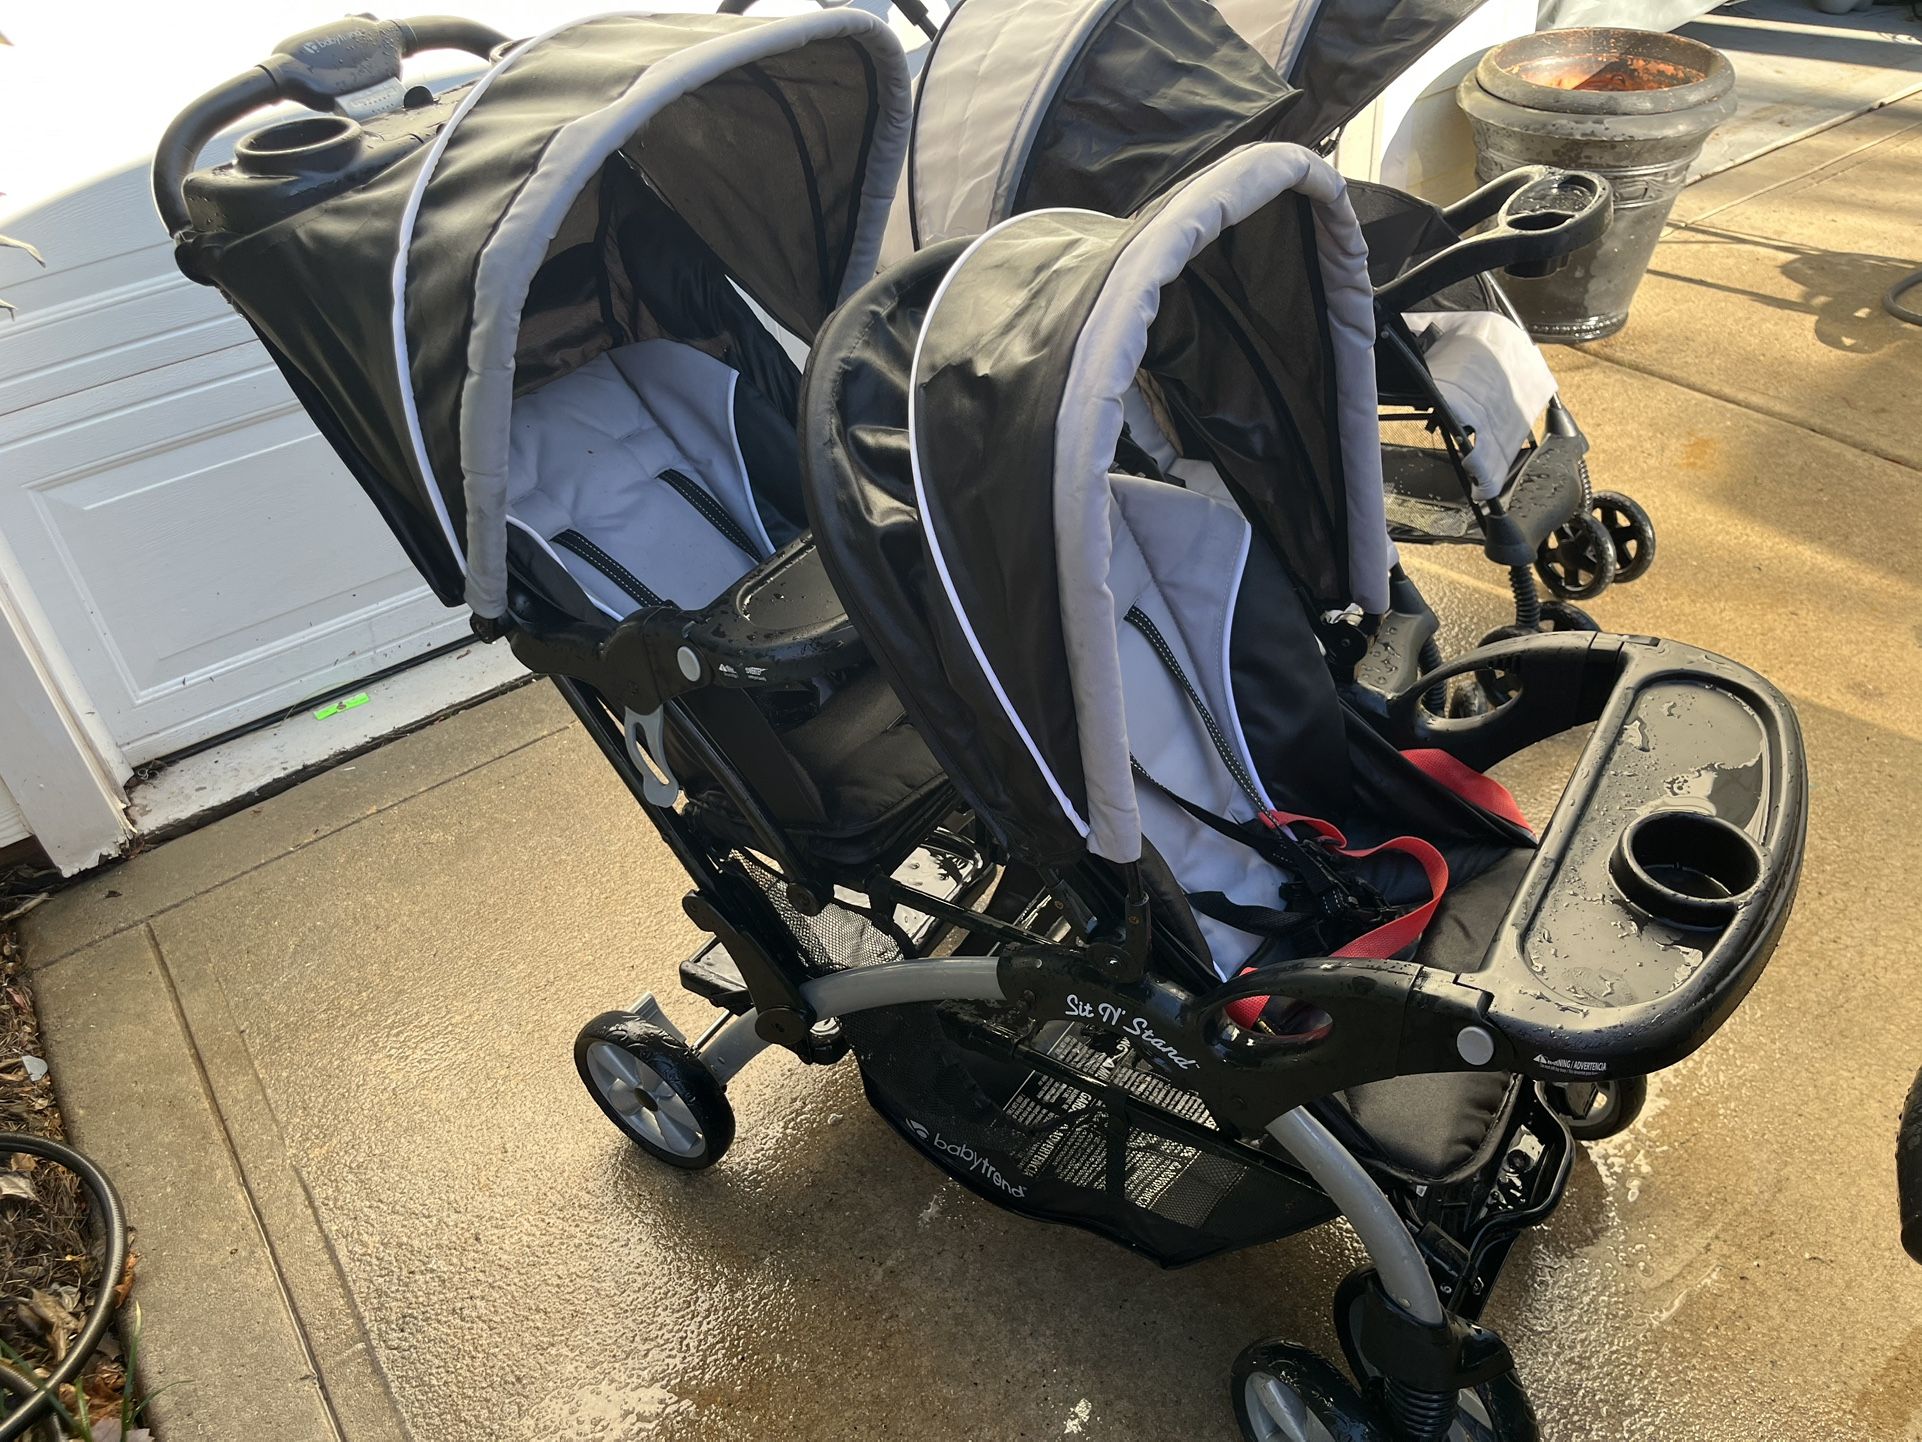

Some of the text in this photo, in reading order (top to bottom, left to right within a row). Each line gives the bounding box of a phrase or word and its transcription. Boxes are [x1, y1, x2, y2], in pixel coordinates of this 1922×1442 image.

[1065, 994, 1095, 1018] Sit
[1122, 1017, 1197, 1070] Stand
[1574, 1061, 1607, 1071] ADVERTENCIA
[933, 1132, 1025, 1198] babytrend
